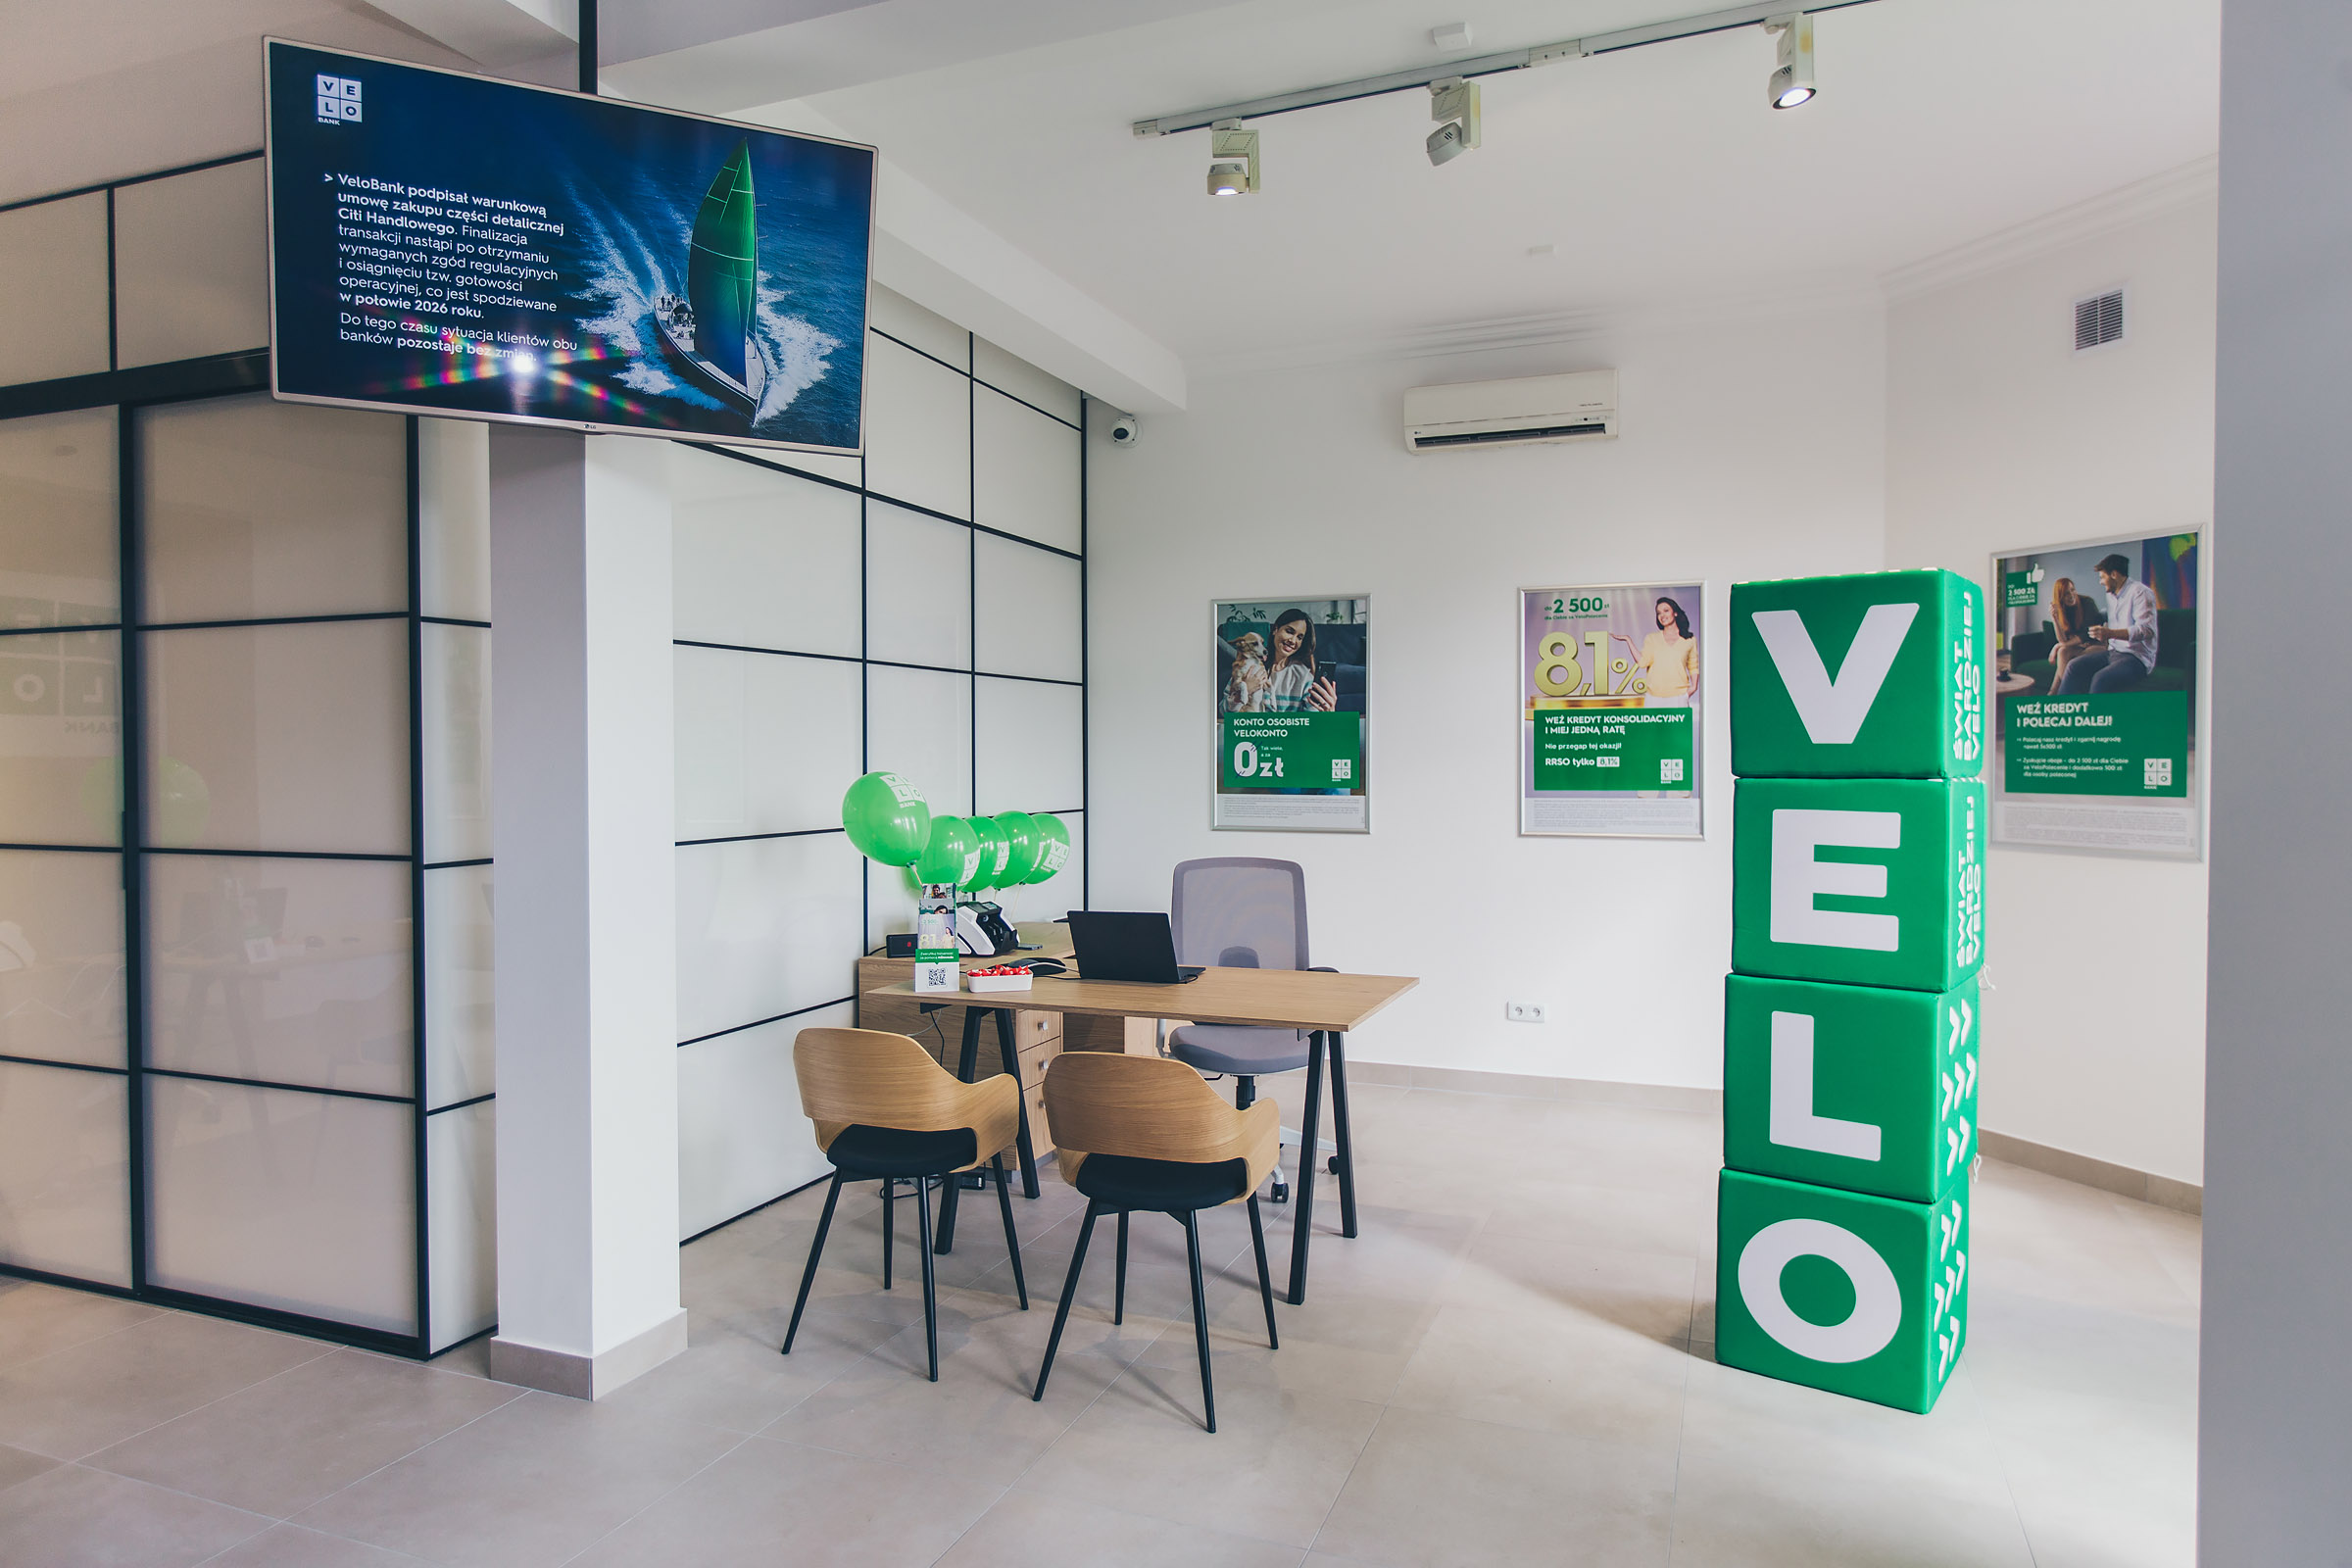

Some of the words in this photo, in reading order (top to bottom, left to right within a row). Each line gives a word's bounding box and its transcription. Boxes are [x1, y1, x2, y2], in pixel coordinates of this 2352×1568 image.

[318, 117, 340, 126] BANK
[337, 172, 405, 195] VeloBank
[408, 186, 468, 204] podpisał
[471, 196, 547, 219] warunkową
[337, 192, 389, 211] umowę
[392, 201, 443, 217] zakupu
[446, 209, 488, 223] części
[492, 214, 564, 236] detalicznej
[338, 208, 363, 221] Citi
[367, 211, 458, 235] Handlowego.
[462, 224, 528, 246] Finalizacja
[338, 223, 402, 245] transakcji
[406, 235, 453, 251] nastąpi
[457, 242, 474, 254] po
[477, 244, 550, 264] otrzymaniu
[338, 242, 428, 264] wymaganych
[431, 255, 466, 269] zgód
[470, 260, 559, 281] regulacyjnych
[339, 257, 343, 269] i
[346, 260, 422, 279] osiągnięciu
[425, 268, 452, 283] tzw.
[456, 274, 523, 292] gotowości
[339, 275, 422, 297] operacyjnej,
[425, 287, 443, 297] co
[446, 287, 469, 301] jest
[472, 292, 558, 312] spodziewane
[339, 292, 352, 303] w
[355, 294, 412, 310] połowie
[415, 299, 448, 314] 2026
[451, 306, 484, 318] roku.
[340, 312, 362, 324] Do
[365, 315, 397, 331] tego
[400, 320, 438, 334] czasu
[441, 324, 494, 342] sytuacja
[497, 330, 550, 347] klientów
[553, 338, 577, 351] obu
[340, 328, 394, 345] banków
[397, 336, 464, 355] pozostaje
[466, 343, 492, 356] bez
[1534, 630, 1647, 697] 8,1%
[1963, 591, 1973, 761] BARDZIEJ
[1567, 715, 1602, 724] KREDYT
[1603, 713, 1686, 724] KONSOLIDACYJNY
[1953, 641, 1963, 760] ŚWIAT
[1972, 664, 1981, 760] VELO
[2043, 702, 2089, 714] KREDYT
[1233, 717, 1265, 726] KONTO
[1266, 717, 1310, 726] OSOBISTE
[1549, 725, 1570, 734] MIEJ
[1571, 725, 1601, 736] JEDNĄ
[1602, 724, 1626, 736] RATĘ
[2016, 717, 2021, 727] I
[2023, 716, 2073, 728] POLECAJ
[2075, 715, 2113, 727] DALEJ!
[1544, 758, 1571, 766] RRSO
[1572, 758, 1595, 767] tylko
[1599, 758, 1618, 766] 8,1%
[1589, 742, 1598, 751] tej
[1599, 742, 1622, 751] okazji!
[1956, 850, 1966, 968] ŚWIAT
